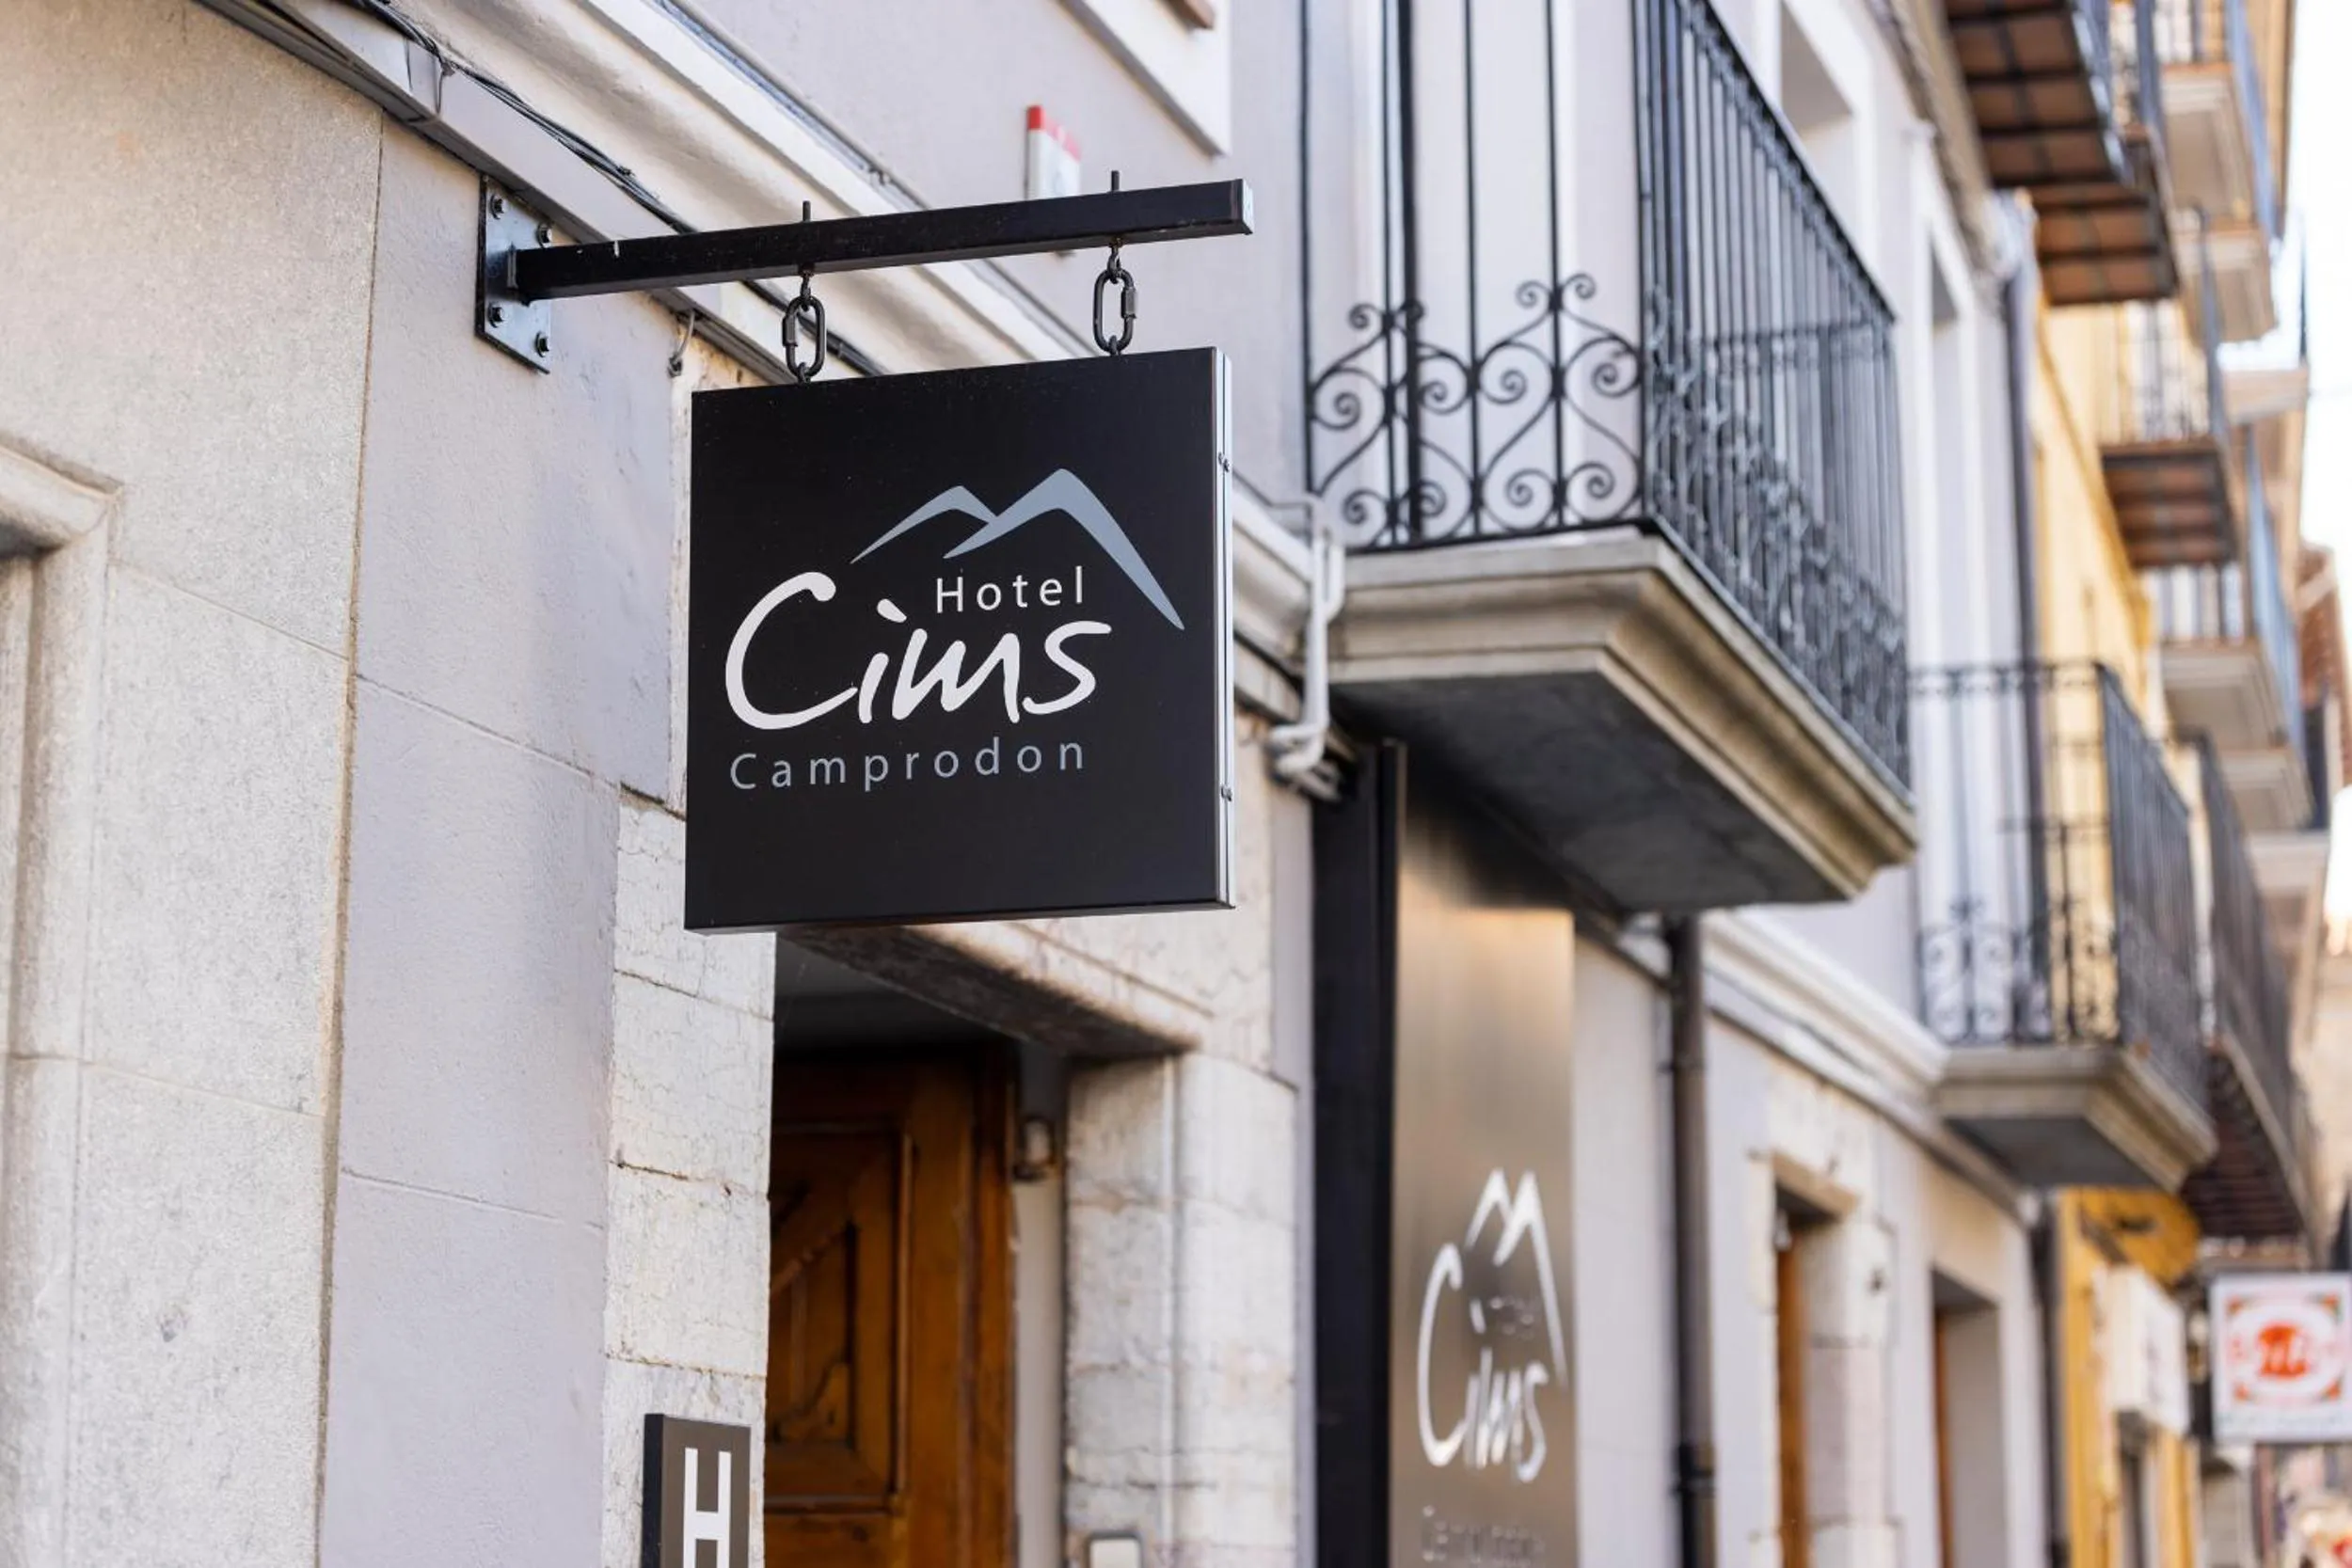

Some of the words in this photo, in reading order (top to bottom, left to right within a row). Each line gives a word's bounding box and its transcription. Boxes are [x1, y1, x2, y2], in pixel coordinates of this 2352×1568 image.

[936, 566, 1083, 613] Hotel
[730, 737, 1083, 791] Camprodon
[683, 1447, 731, 1568] H
